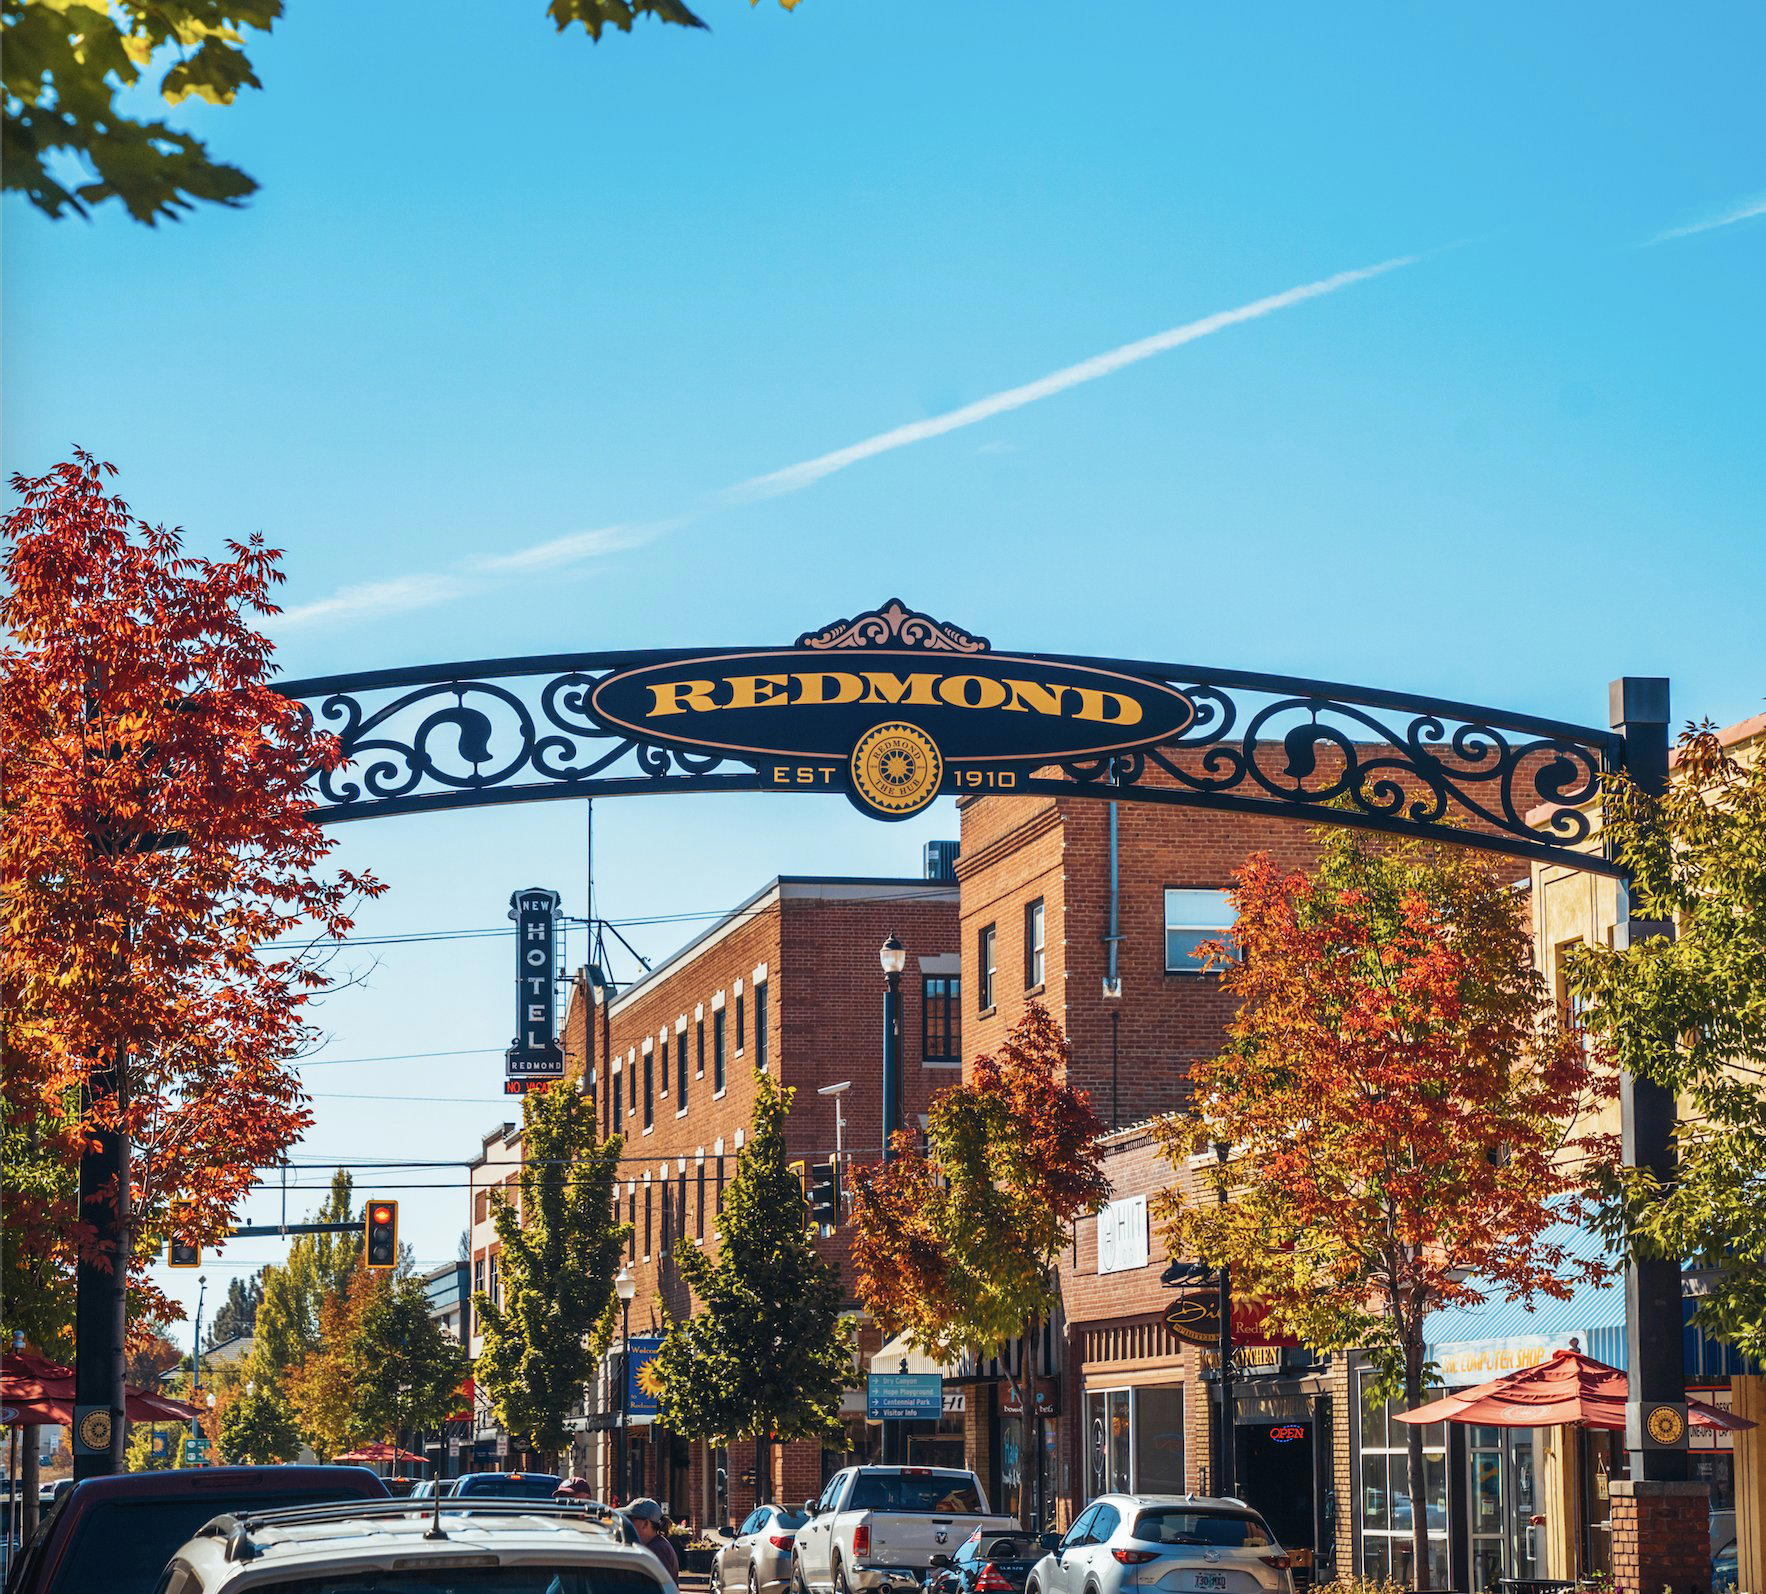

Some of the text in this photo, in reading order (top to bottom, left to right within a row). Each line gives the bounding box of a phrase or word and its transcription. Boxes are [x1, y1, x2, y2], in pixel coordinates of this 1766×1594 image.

[645, 672, 1144, 726] REDMOND
[873, 740, 921, 760] REDMOND
[773, 767, 836, 783] EST
[954, 770, 1017, 788] 1910
[875, 779, 920, 795] THE HUB
[523, 901, 550, 911] NEW
[526, 922, 546, 1049] HOTEL
[511, 1061, 562, 1070] REDMOND
[507, 1082, 521, 1093] NO
[631, 1346, 658, 1354] Welcom
[1461, 1349, 1513, 1373] COMPUTER
[1516, 1345, 1545, 1369] SHOP
[895, 1377, 918, 1385] Canyon
[900, 1388, 934, 1396] Playground
[883, 1398, 915, 1406] Centennial
[1269, 1427, 1305, 1439] OPEN
